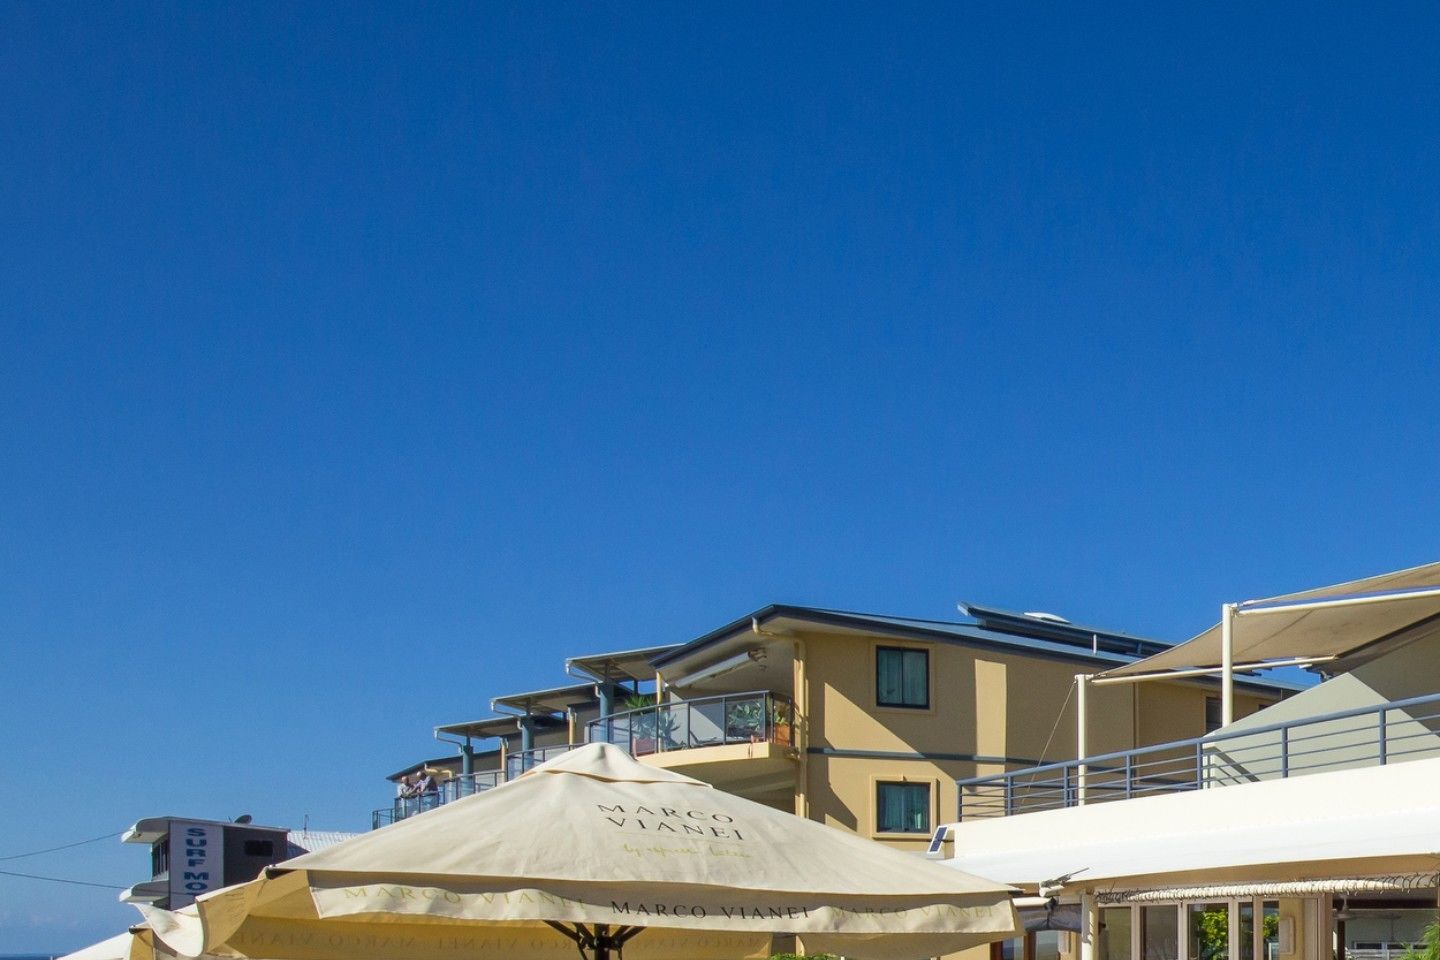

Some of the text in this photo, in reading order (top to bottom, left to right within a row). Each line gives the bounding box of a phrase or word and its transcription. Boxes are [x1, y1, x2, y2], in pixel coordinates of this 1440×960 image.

[597, 804, 734, 823] MARCO
[607, 817, 744, 841] VIANEI
[184, 828, 209, 895] SURF MO
[344, 886, 462, 905] MARCO
[611, 900, 809, 920] MARCO VIANEI
